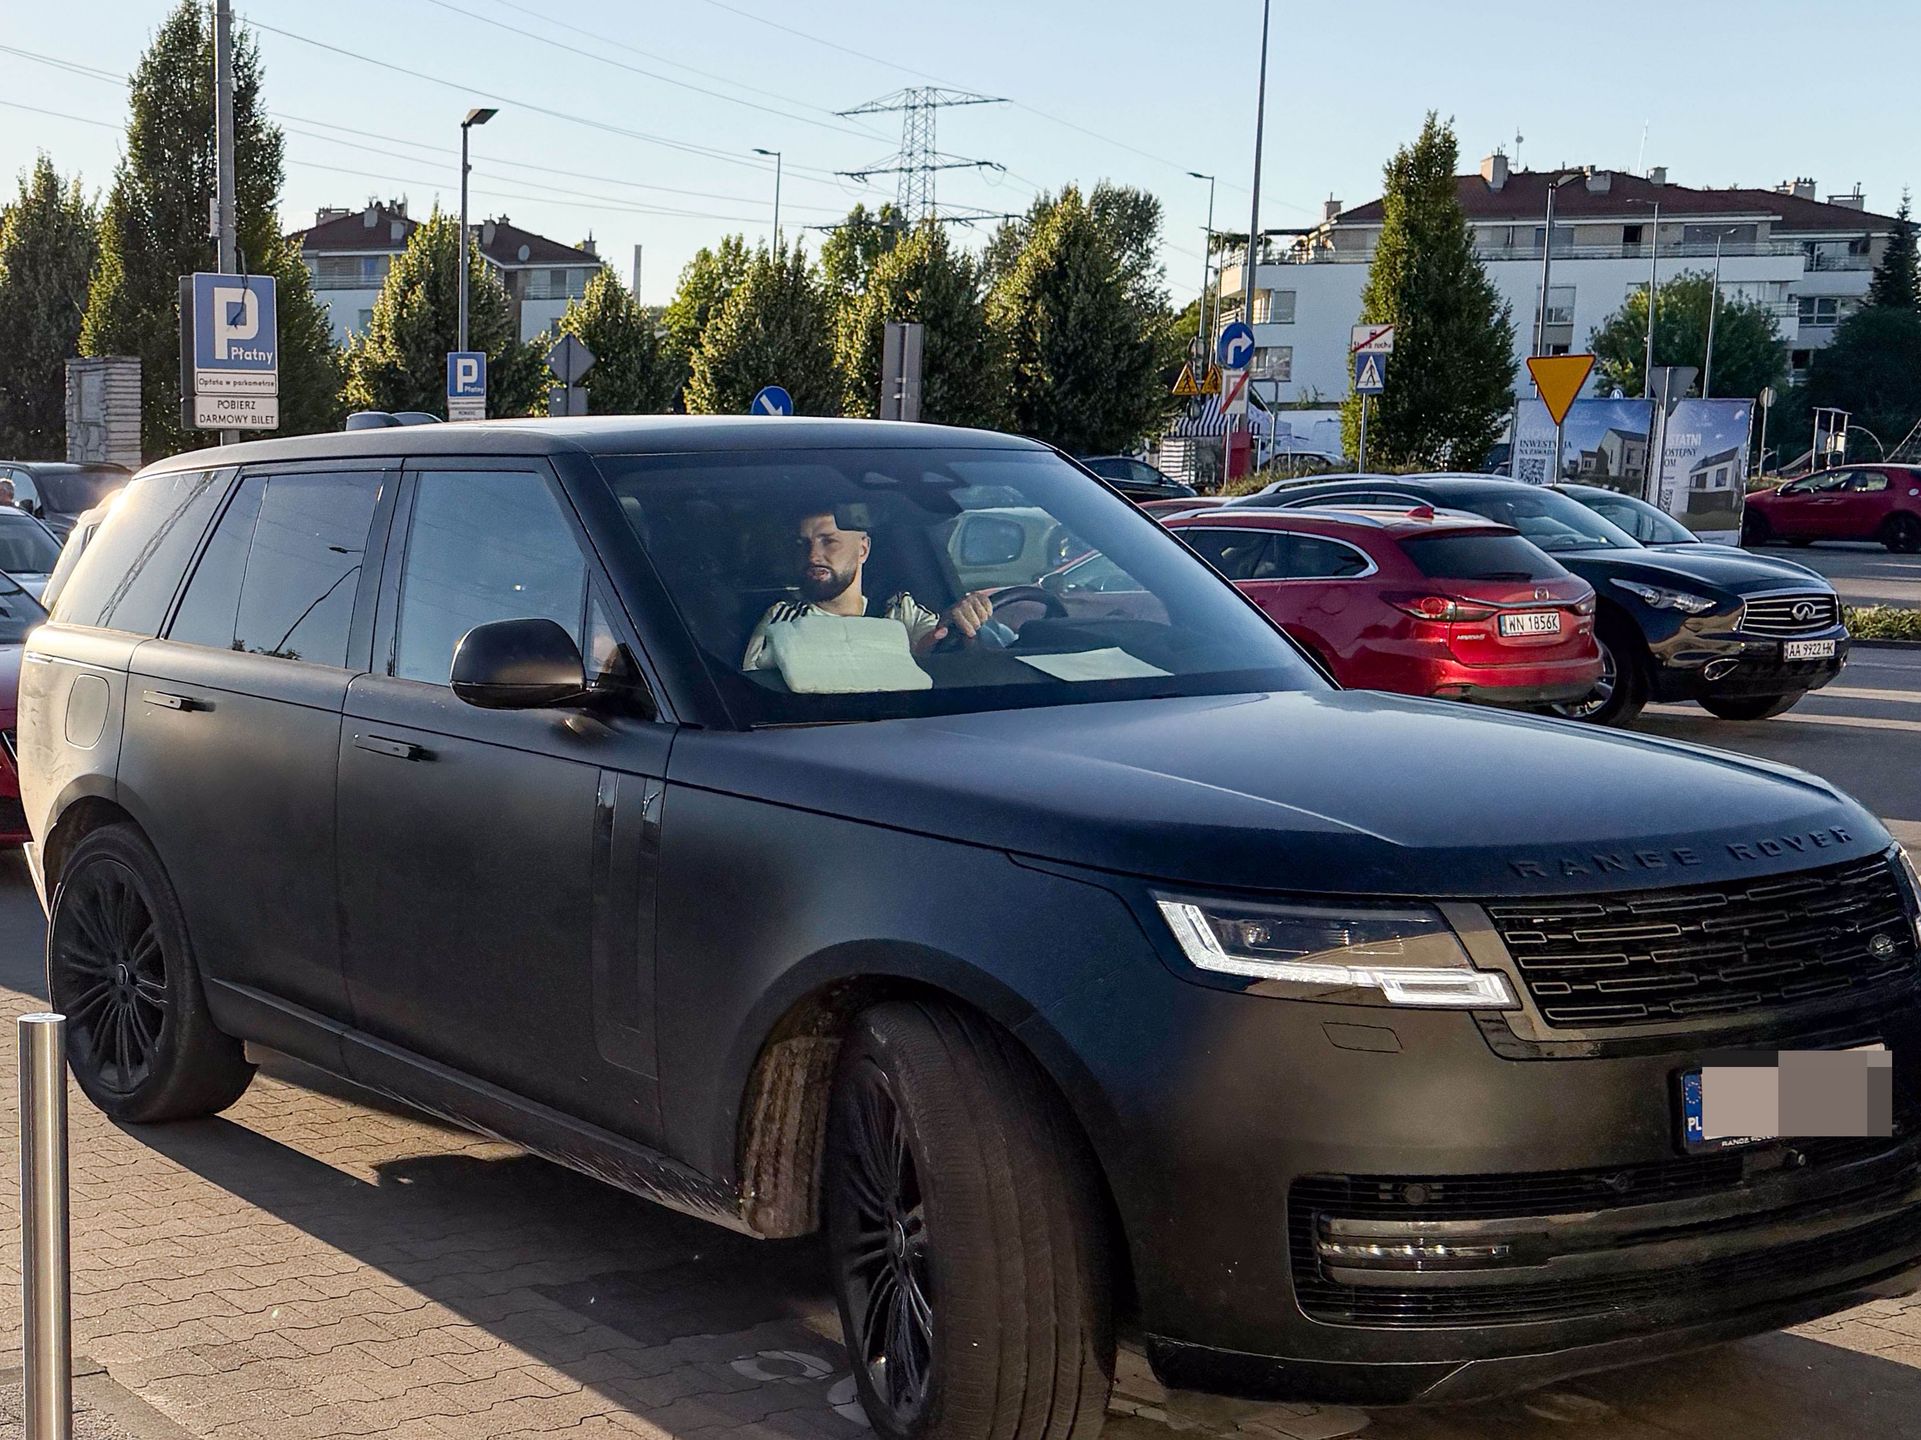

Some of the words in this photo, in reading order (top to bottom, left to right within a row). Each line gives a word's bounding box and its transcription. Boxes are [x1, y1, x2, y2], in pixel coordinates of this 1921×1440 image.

[214, 287, 259, 360] P
[231, 346, 273, 365] Płatny
[457, 359, 478, 392] P
[217, 400, 256, 410] POBIERZ
[199, 414, 248, 424] DARMOWY
[251, 415, 275, 425] BILET
[1519, 439, 1573, 449] INWESTYJA
[1664, 447, 1696, 458] OSTĘPNY
[1663, 458, 1676, 467] OM
[1508, 616, 1525, 631] WN
[1528, 614, 1558, 630] 1856K
[1789, 644, 1801, 656] AA
[1507, 847, 1701, 879] RANGE
[1726, 825, 1853, 861] ROVER
[1687, 1116, 1702, 1132] PL
[1721, 1137, 1750, 1147] RANGE
